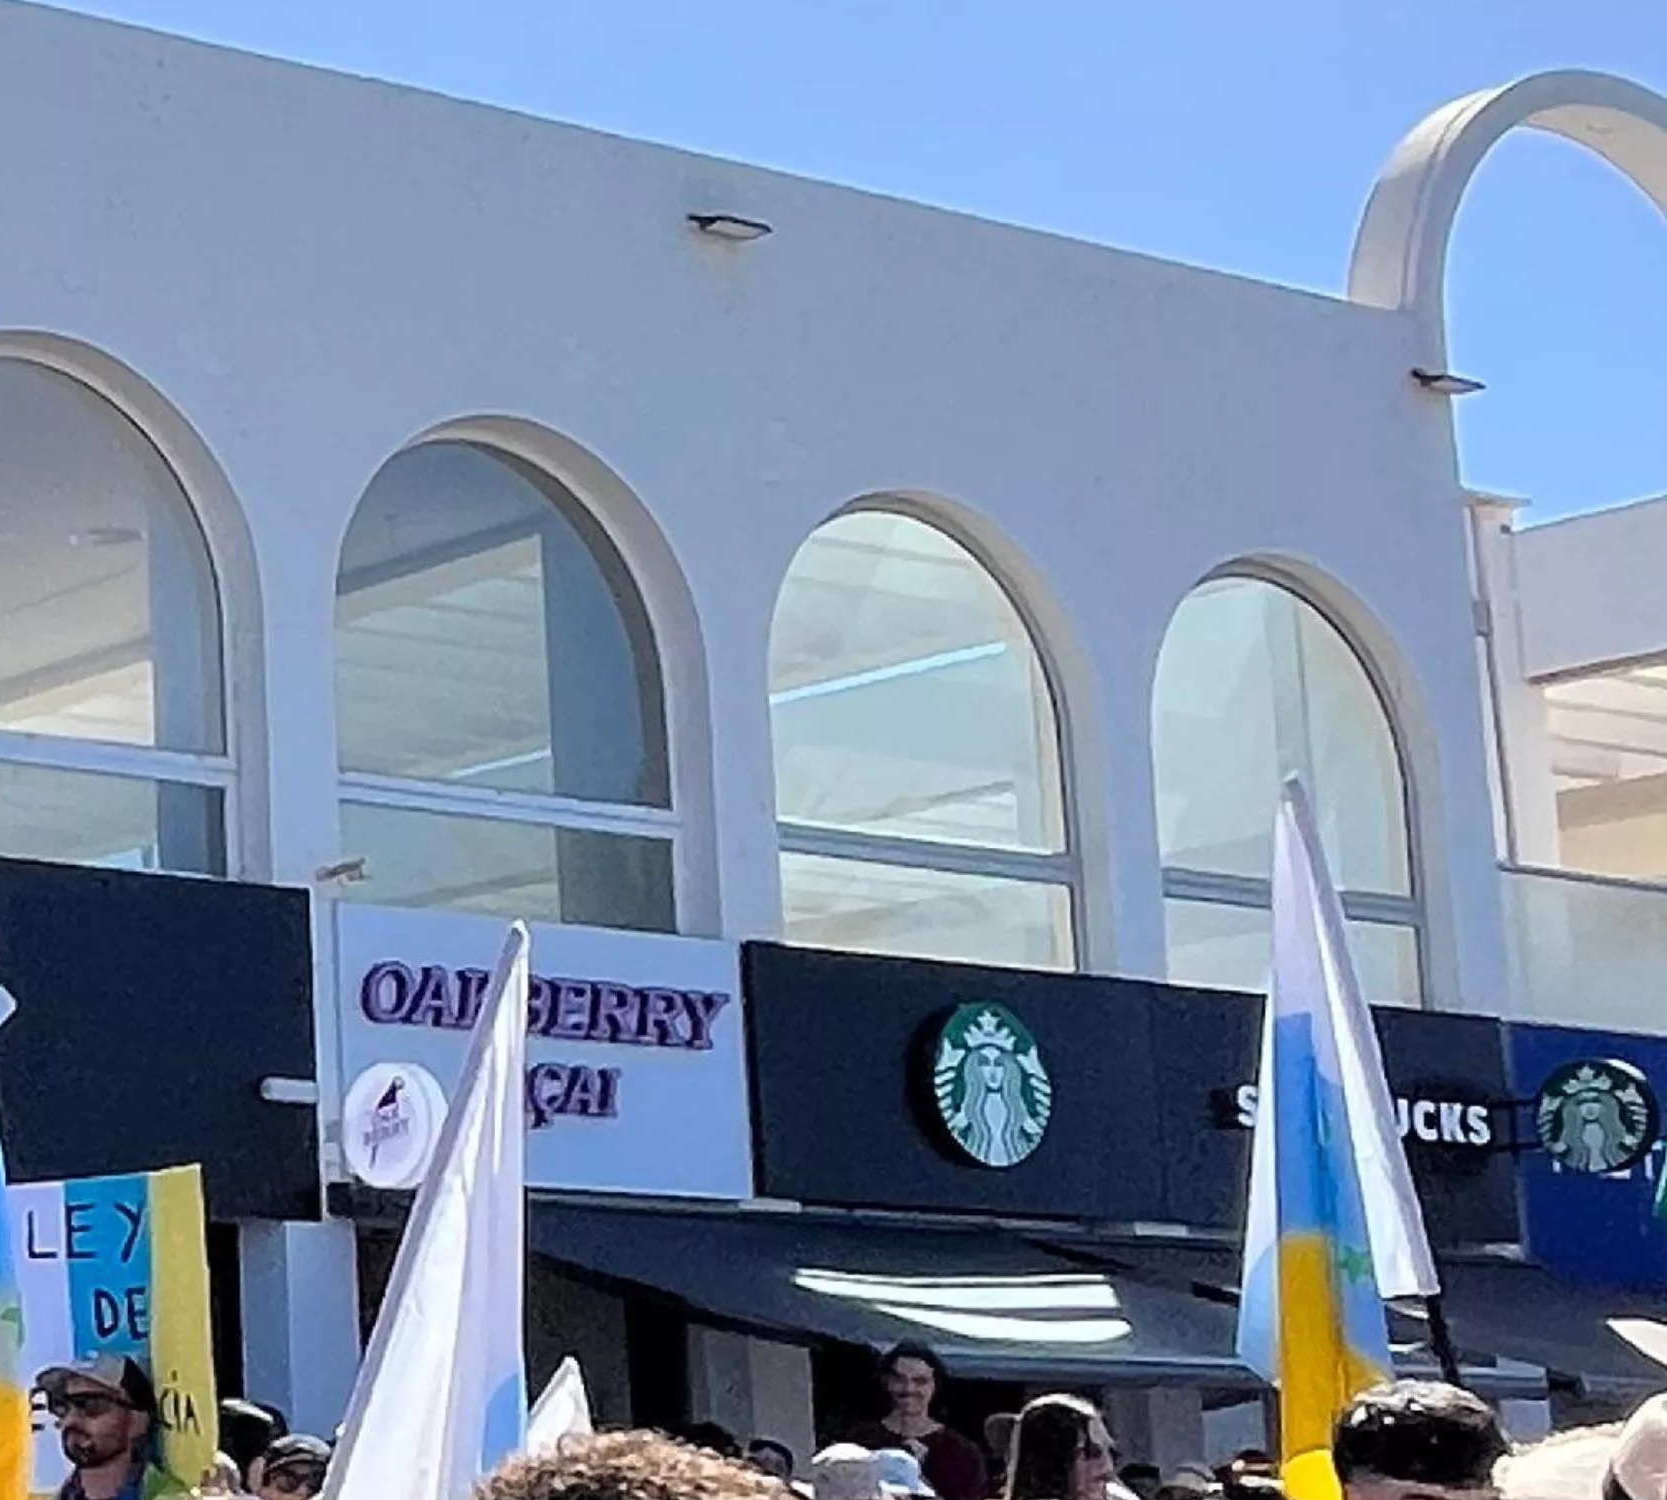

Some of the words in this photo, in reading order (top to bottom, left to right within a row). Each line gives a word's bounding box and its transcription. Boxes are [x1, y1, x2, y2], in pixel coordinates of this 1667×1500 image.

[1237, 1083, 1491, 1146] SUCKS
[27, 1201, 144, 1263] LEY
[93, 1286, 148, 1342] DE
